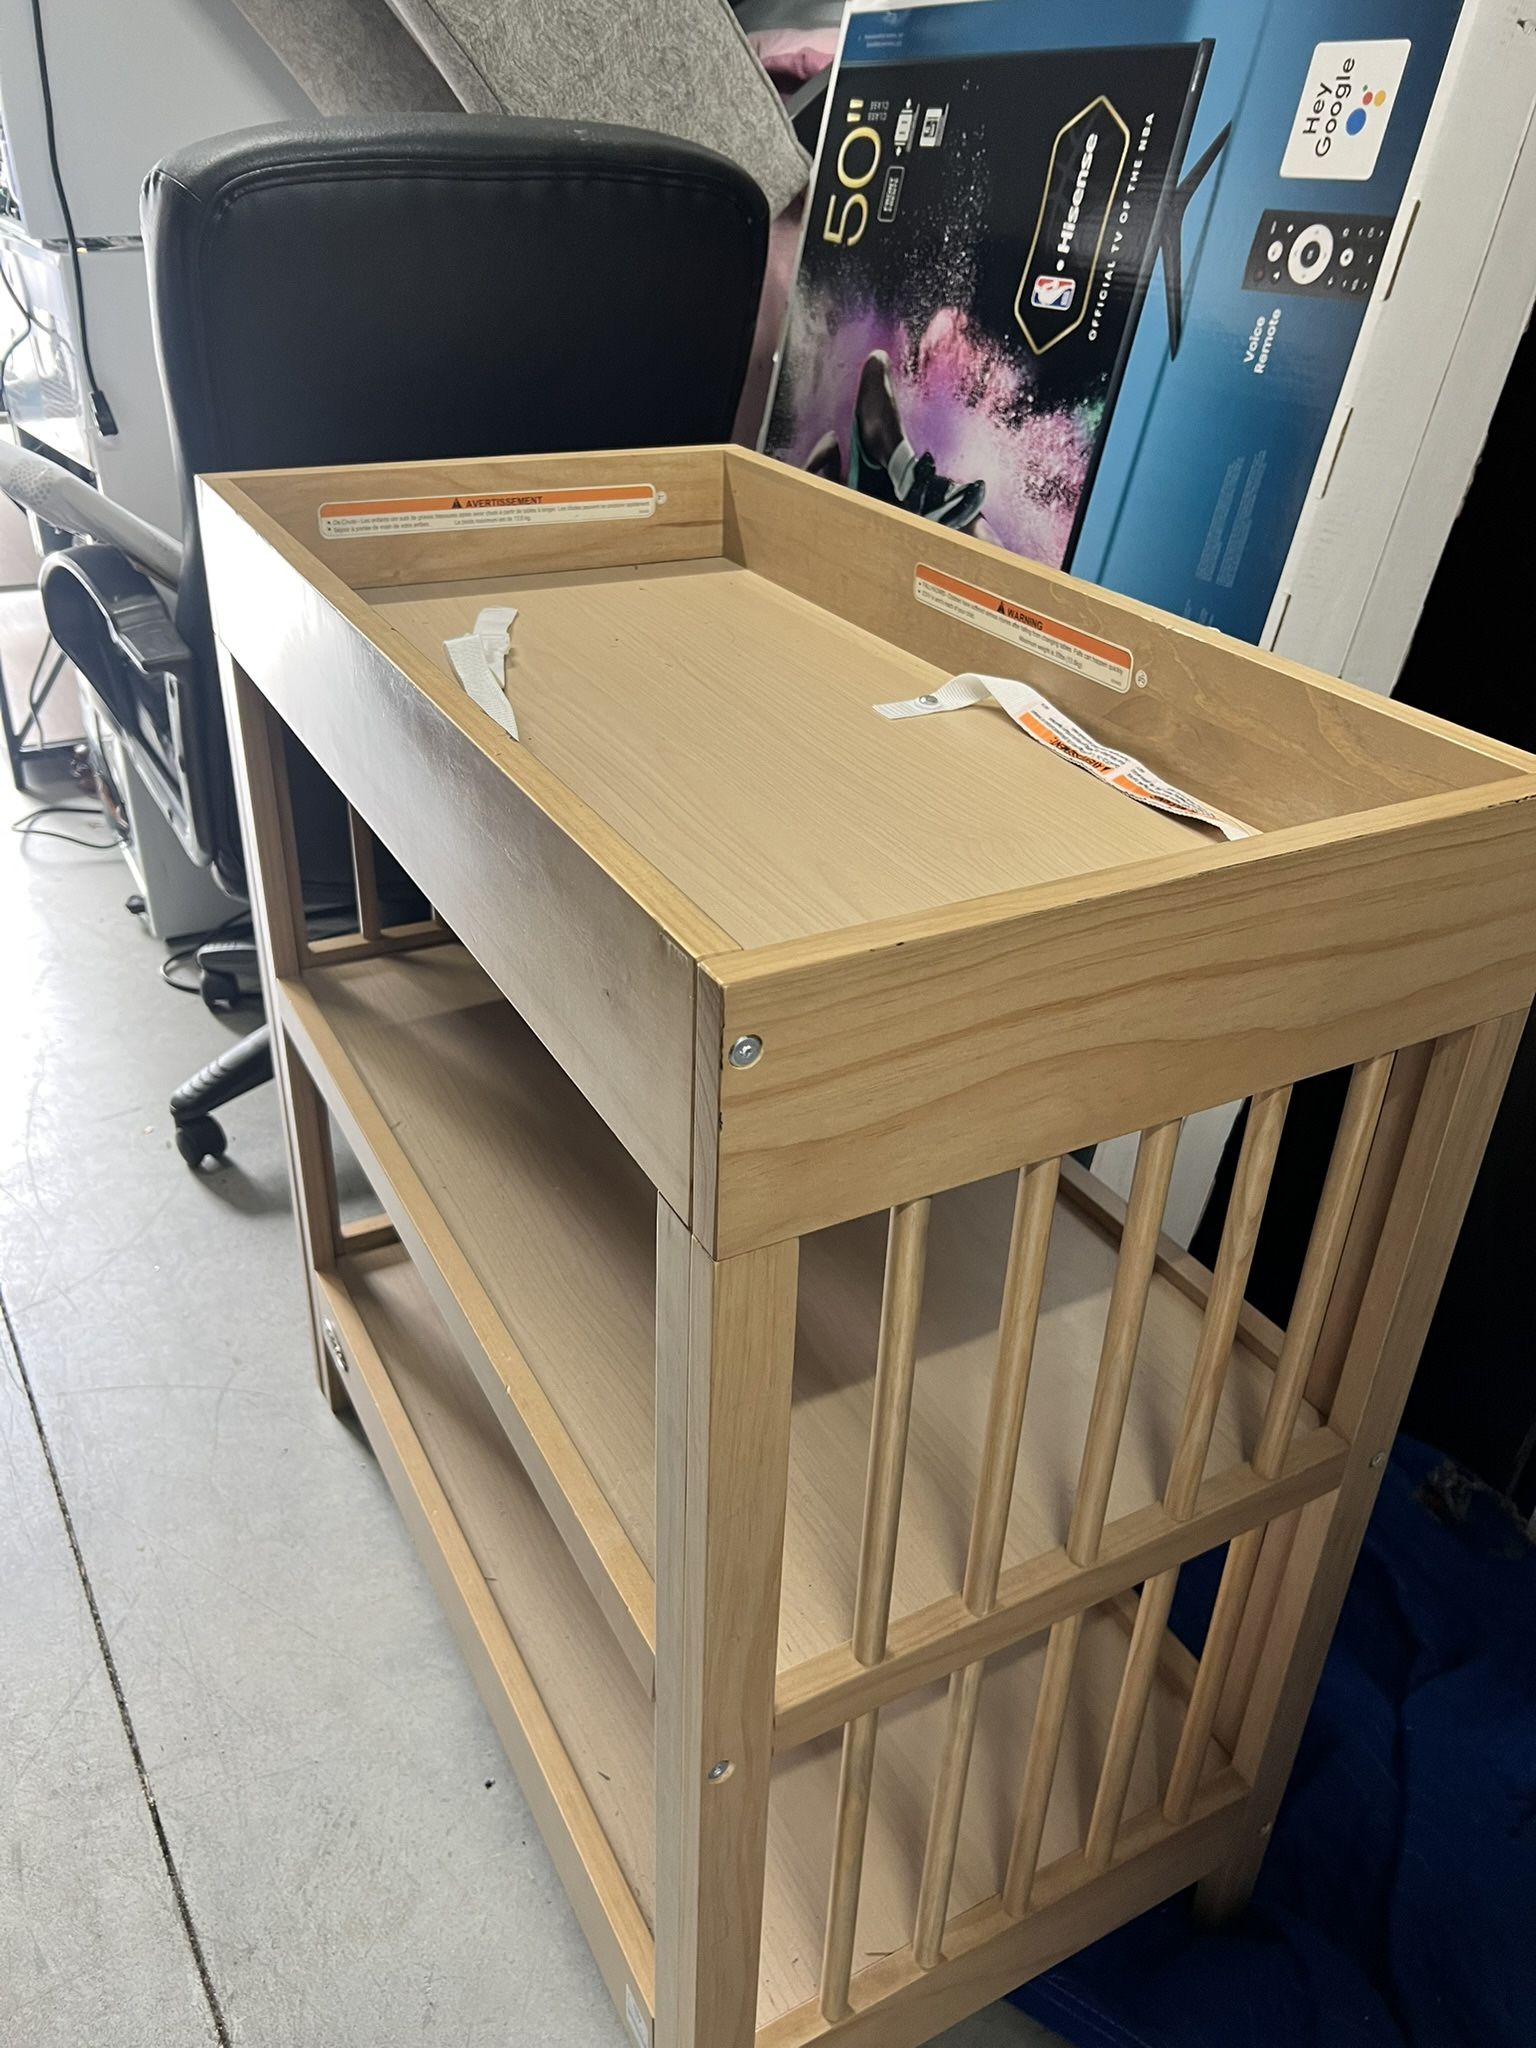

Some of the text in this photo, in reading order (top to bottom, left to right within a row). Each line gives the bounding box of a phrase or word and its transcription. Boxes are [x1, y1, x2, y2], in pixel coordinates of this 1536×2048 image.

[1302, 82, 1333, 134] Hey
[1315, 57, 1355, 157] Google
[1057, 132, 1098, 254] Hisense
[1088, 112, 1155, 342] OFFICIAL TV OF THE NBA
[1243, 315, 1266, 363] Voice
[1253, 308, 1282, 374] Remote
[465, 495, 543, 508] AVERTISSEMENT
[1007, 608, 1044, 631] WARNING
